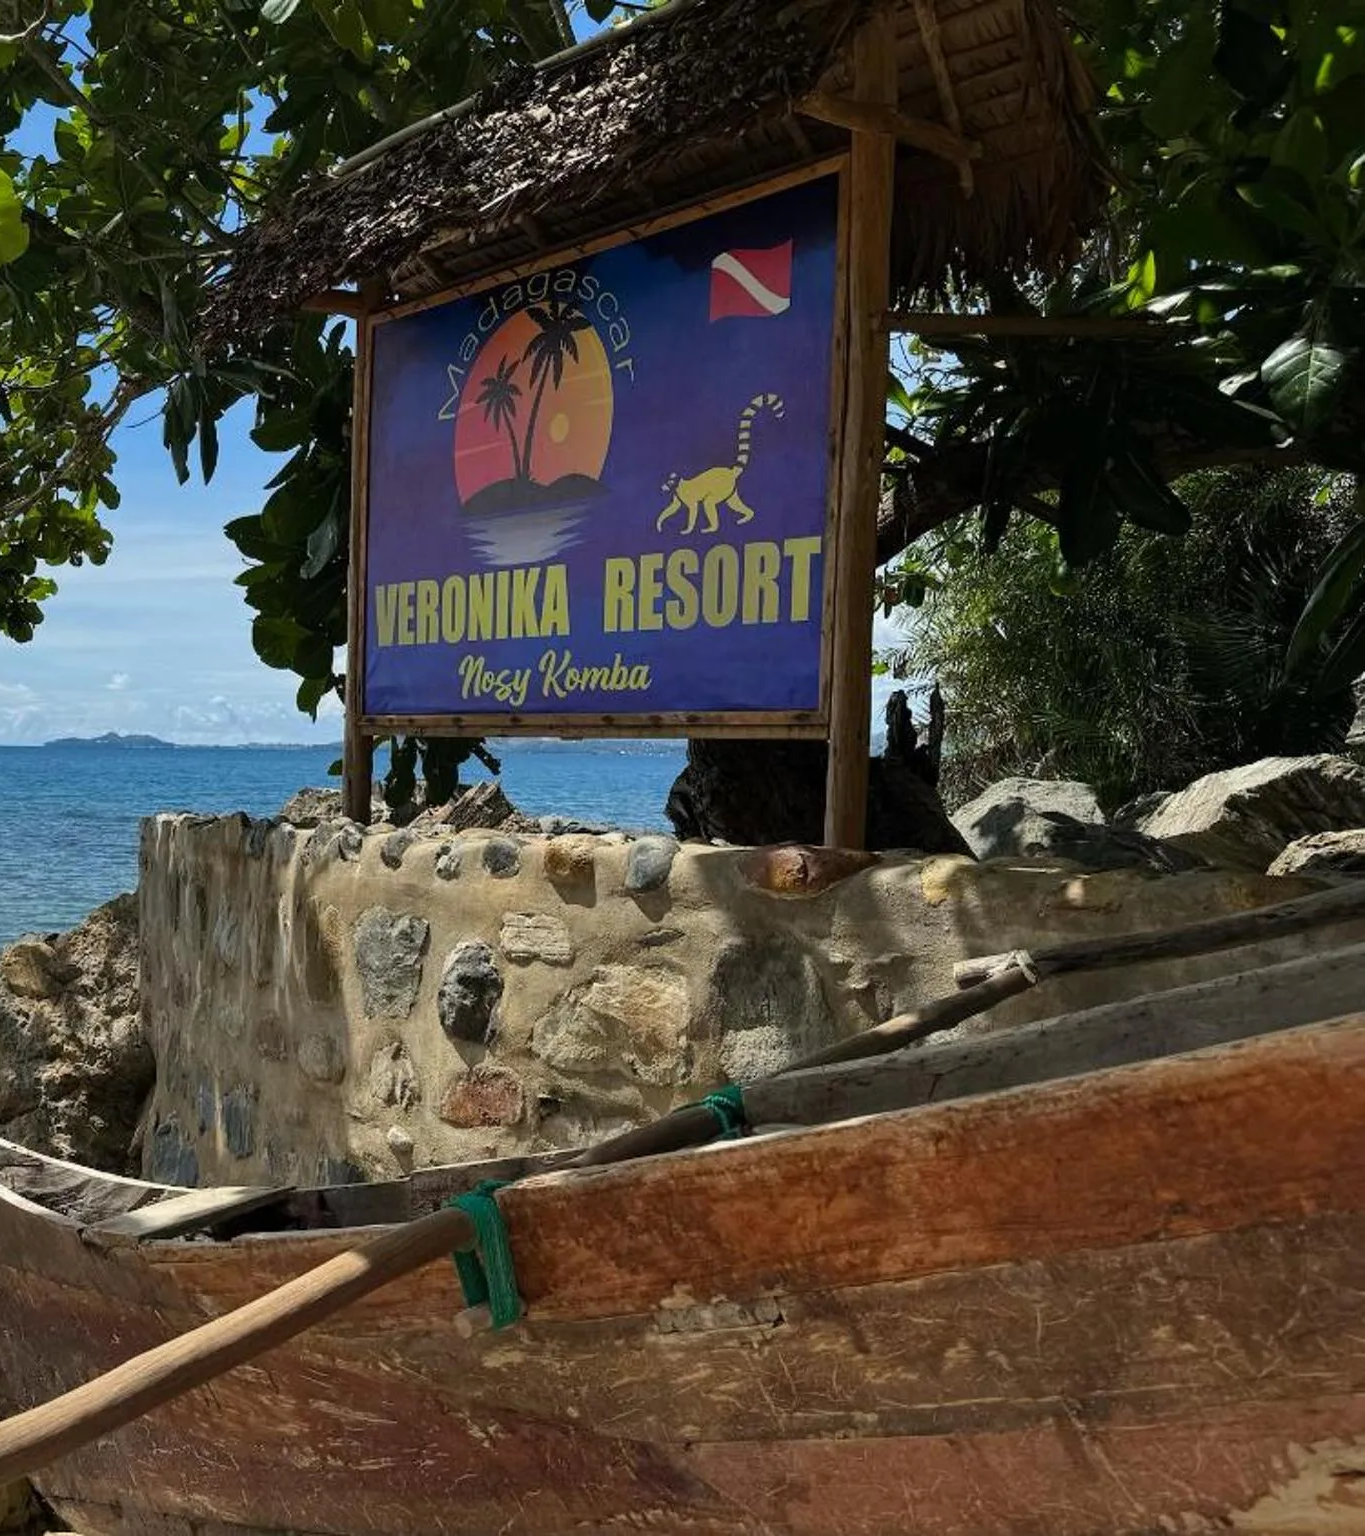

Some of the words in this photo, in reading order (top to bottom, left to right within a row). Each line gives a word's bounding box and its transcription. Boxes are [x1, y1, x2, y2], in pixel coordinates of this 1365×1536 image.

[437, 269, 635, 422] Madagascar
[375, 564, 571, 648] VERONIKA
[603, 536, 822, 632] RESORT
[457, 654, 530, 707] Nosy
[538, 648, 651, 698] Komba
